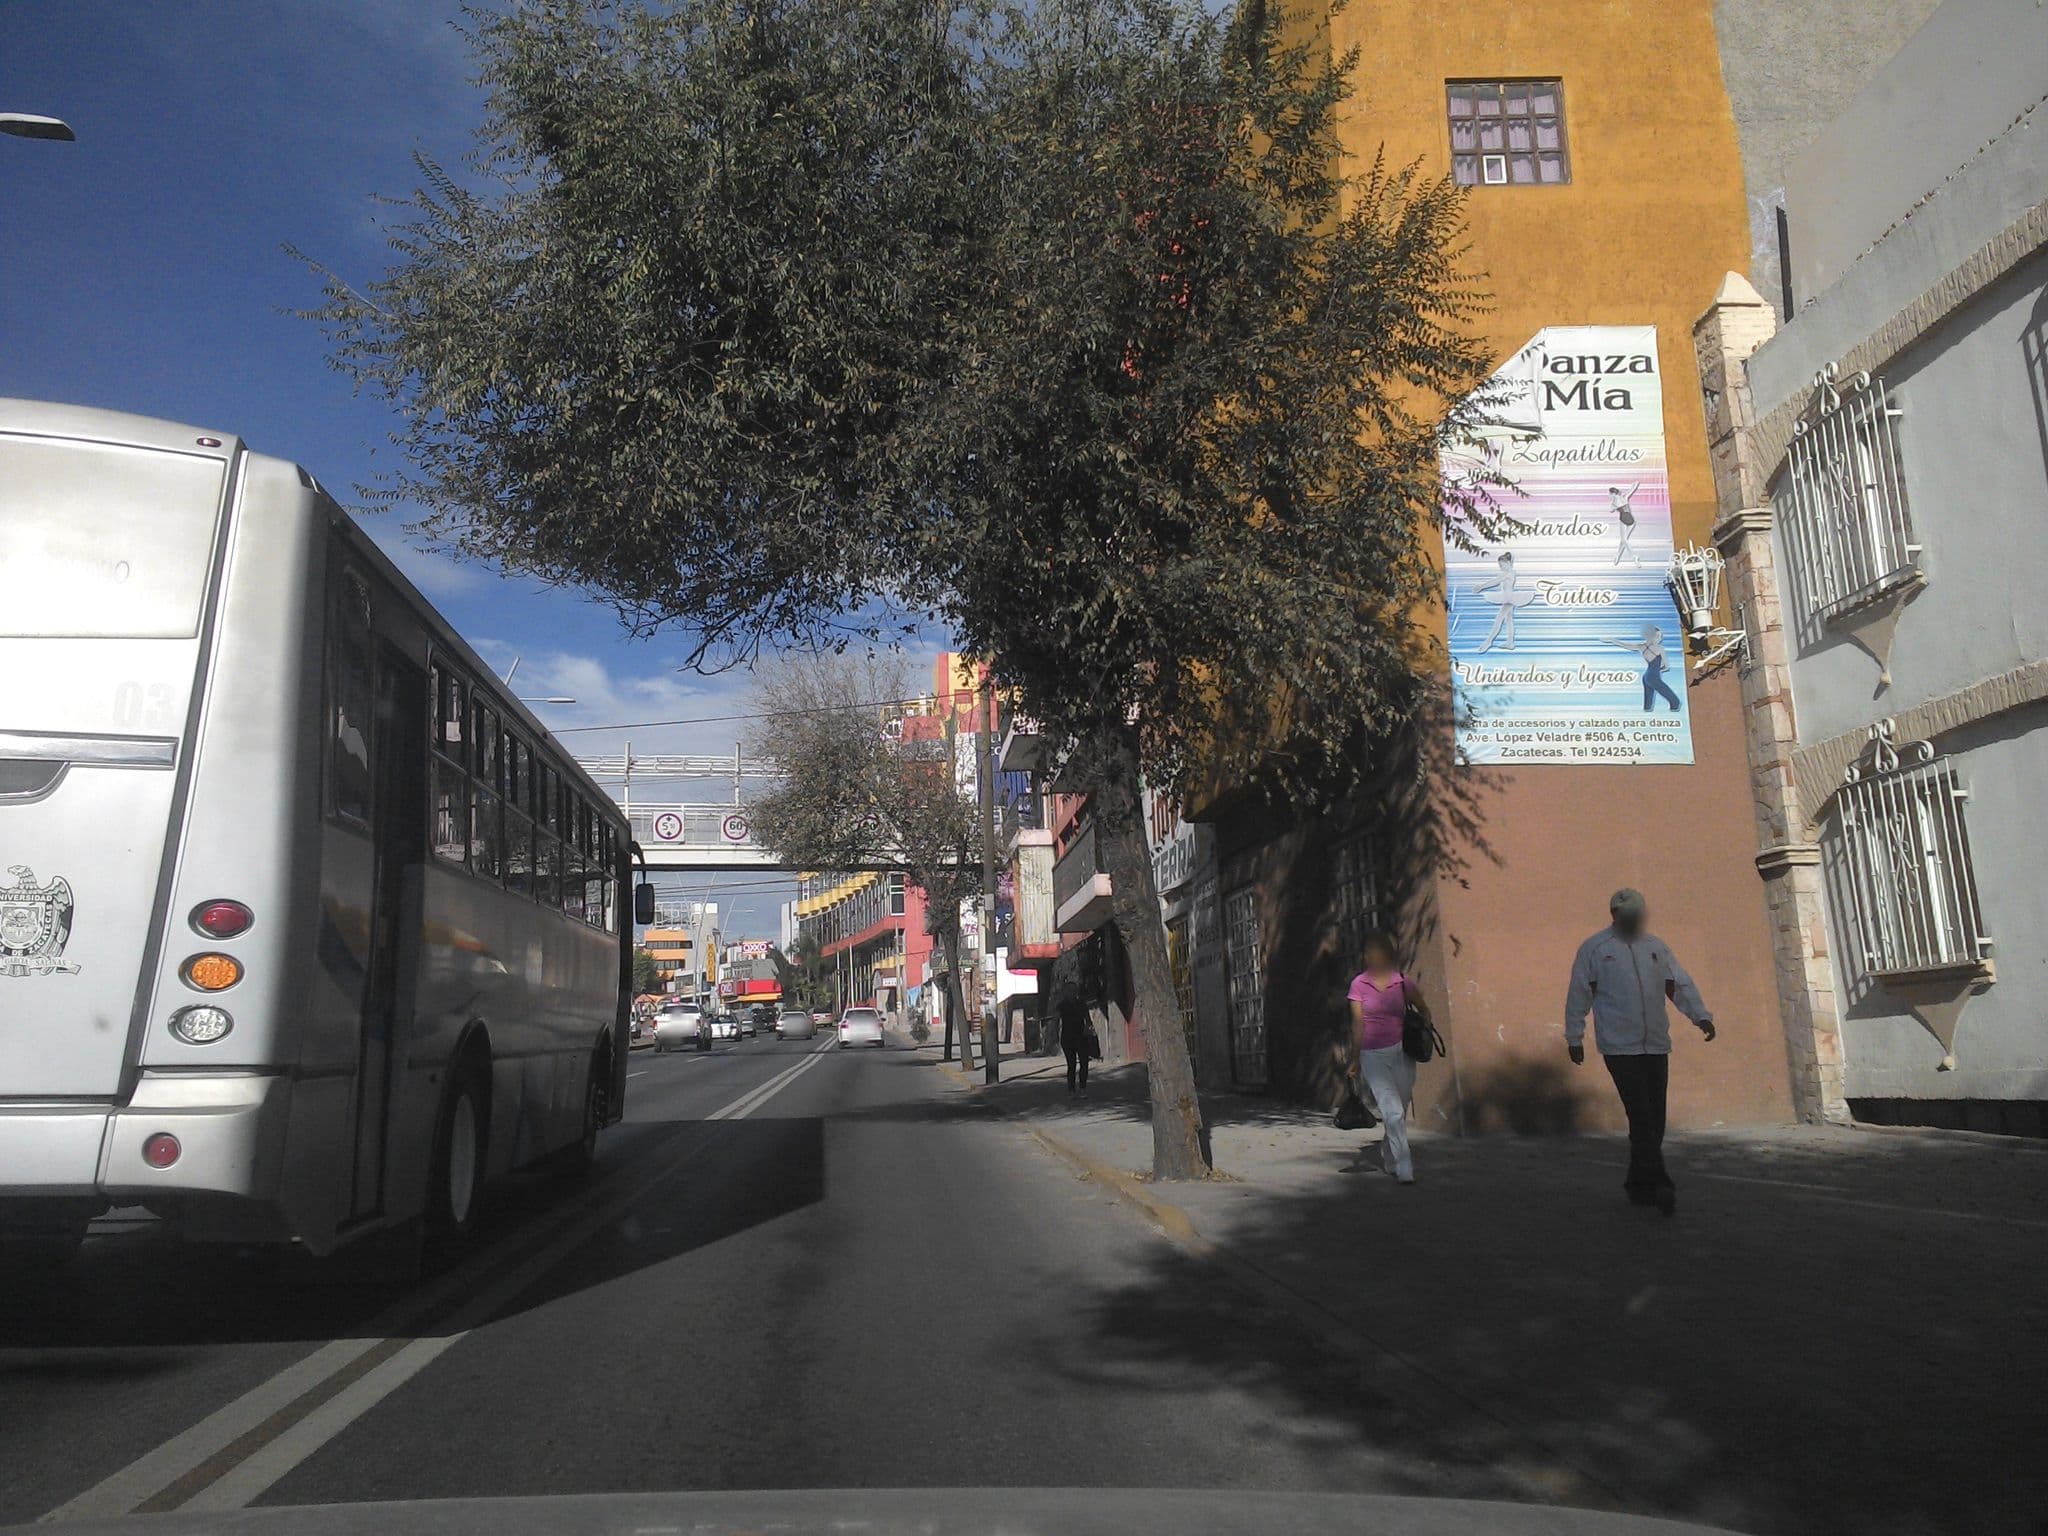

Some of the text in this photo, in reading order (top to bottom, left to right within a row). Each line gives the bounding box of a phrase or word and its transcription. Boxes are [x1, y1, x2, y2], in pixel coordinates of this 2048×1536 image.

[1543, 353, 1654, 374] anza
[1541, 378, 1634, 411] Mía
[1511, 439, 1644, 469] Zapatillas
[1537, 580, 1617, 605] Tutus
[1458, 664, 1637, 689] Unitardos y lycras
[1492, 719, 1504, 728] de
[1508, 719, 1566, 728] accesorios
[1569, 721, 1576, 729] y
[1579, 719, 1620, 728] calzado
[1623, 721, 1646, 729] para
[1650, 719, 1681, 728] danza
[1536, 732, 1581, 742] Veladre
[1585, 732, 1614, 742] #506
[1617, 732, 1630, 743] A,
[1633, 732, 1678, 743] Centro,
[1501, 747, 1567, 757] Zacatecas.
[1571, 747, 1588, 757] Tel
